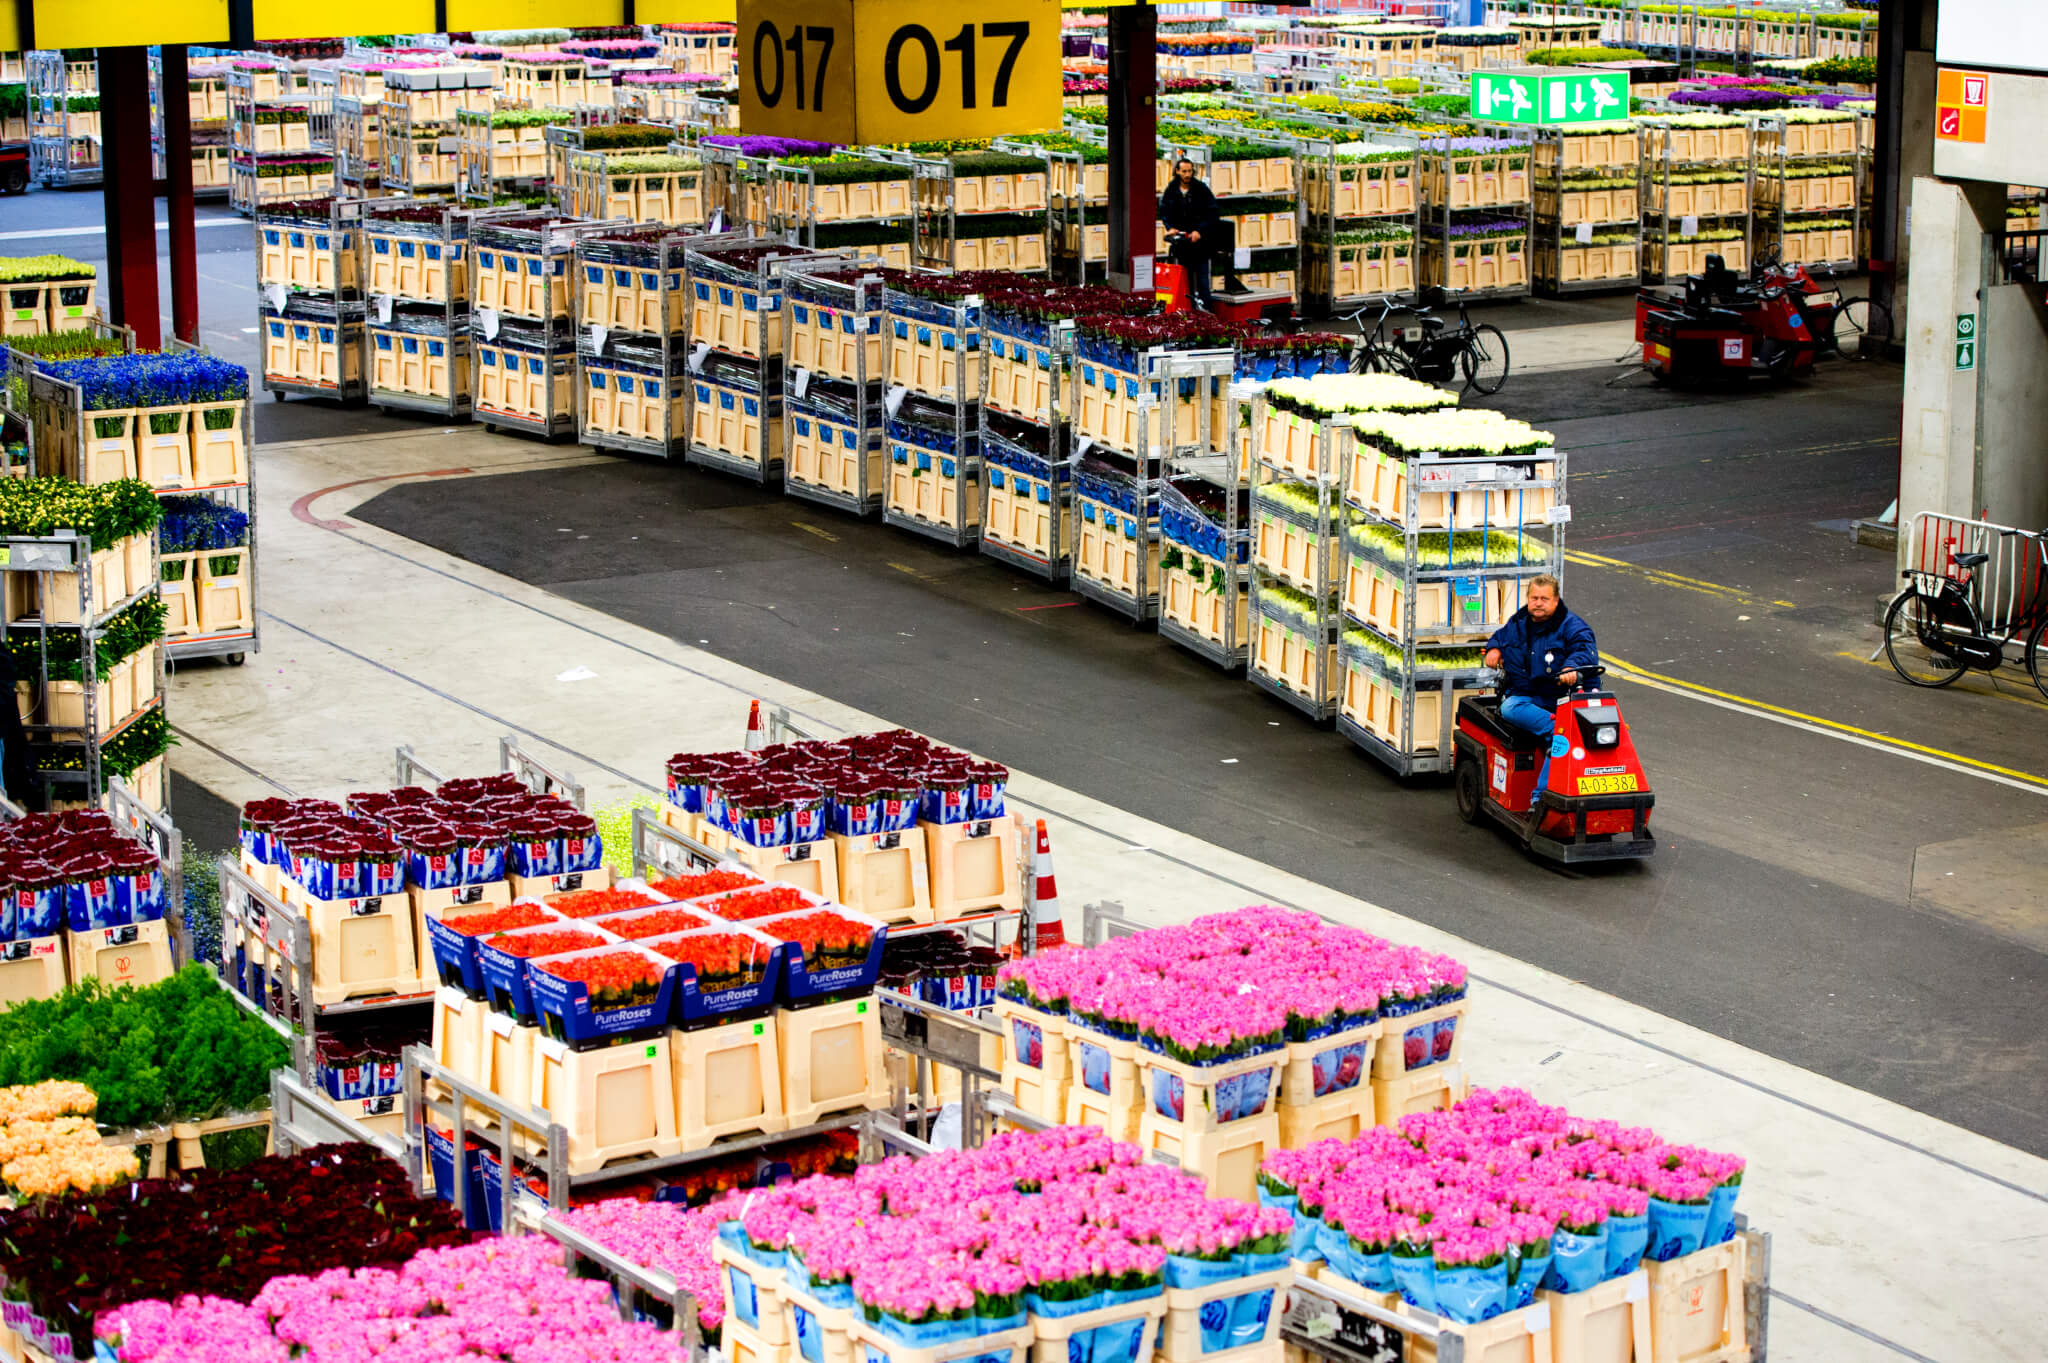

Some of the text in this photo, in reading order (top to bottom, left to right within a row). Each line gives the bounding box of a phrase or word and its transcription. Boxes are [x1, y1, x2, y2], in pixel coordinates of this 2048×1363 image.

[753, 19, 835, 113] 017
[884, 21, 1030, 115] 017
[1580, 775, 1637, 793] A-03-382
[809, 967, 863, 985] PureRoses
[703, 987, 759, 1006] PureRoses
[594, 1007, 652, 1026] PureRoses
